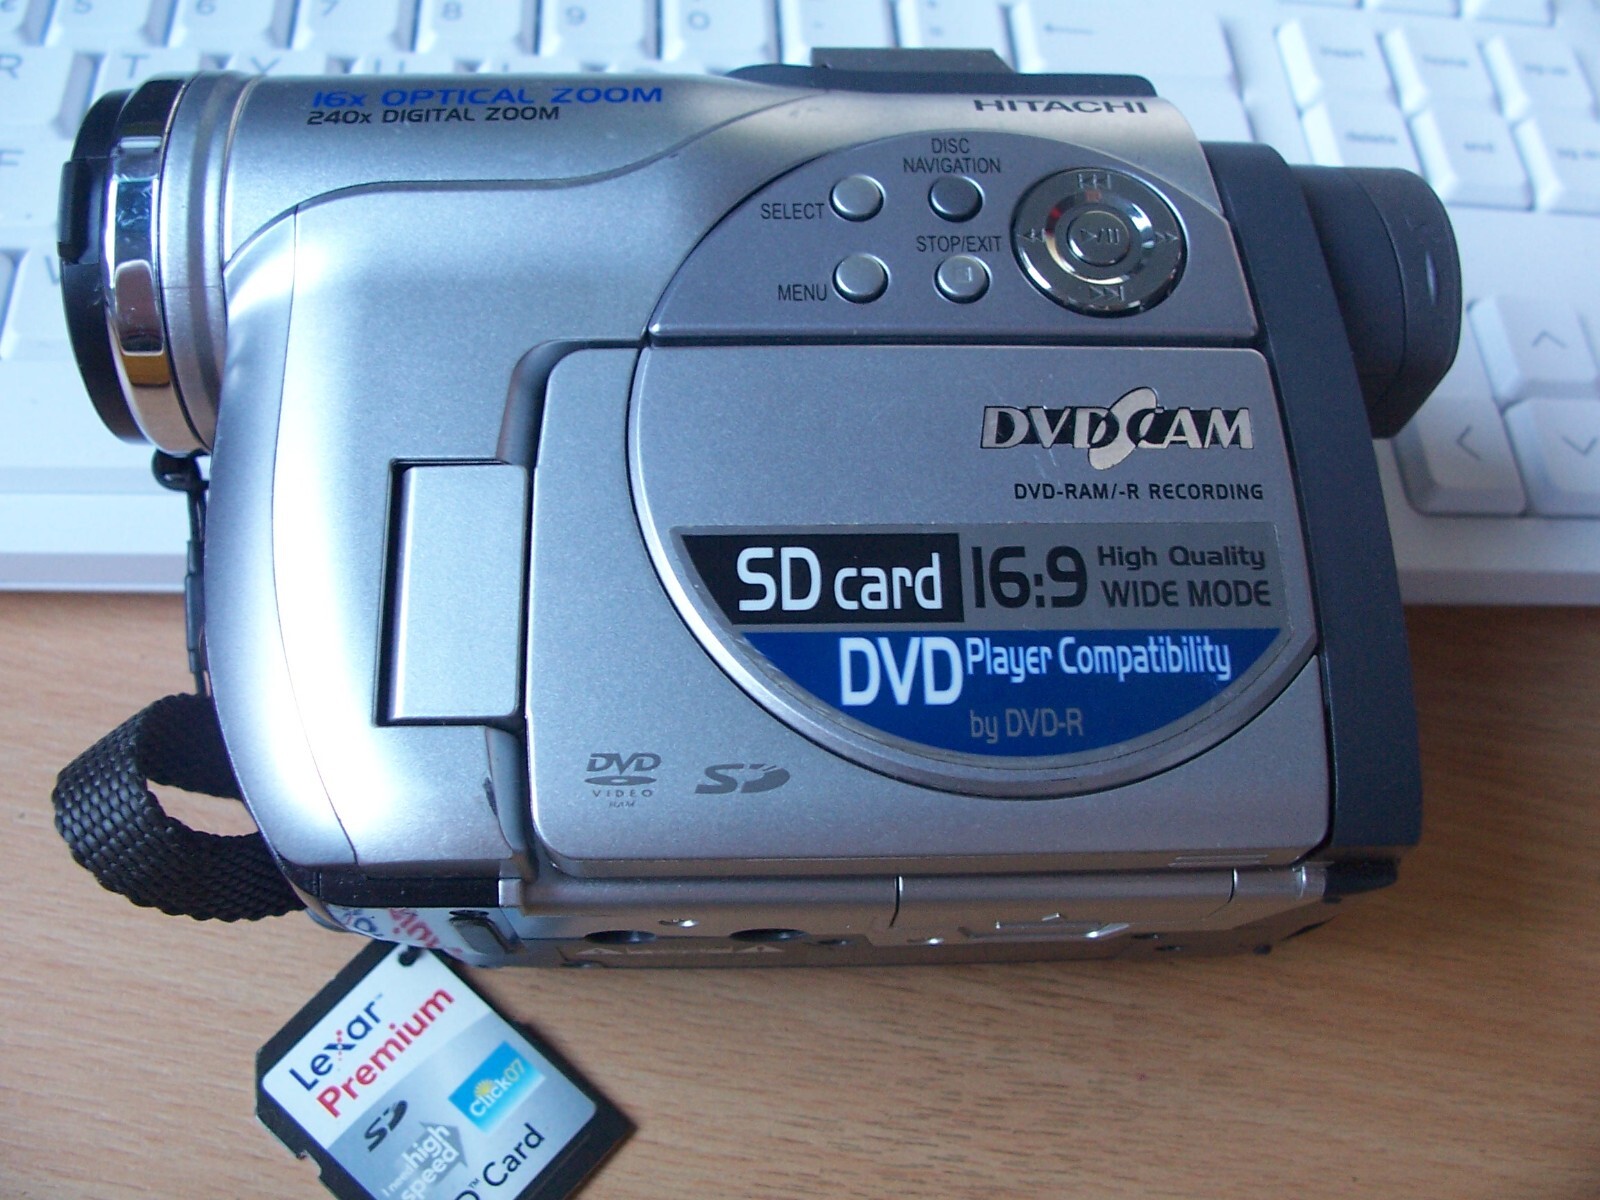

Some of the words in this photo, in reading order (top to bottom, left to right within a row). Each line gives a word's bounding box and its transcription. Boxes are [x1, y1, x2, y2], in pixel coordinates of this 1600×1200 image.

[441, 1, 463, 21] 8
[565, 5, 587, 26] 9
[121, 54, 149, 79] T
[312, 91, 368, 108] 16x
[381, 88, 533, 107] OPTICAL
[551, 86, 664, 104] ZOOM
[973, 98, 1149, 114] HITACHI
[306, 109, 373, 125] 240x
[381, 107, 476, 124] DIGITAL
[485, 106, 561, 121] ZOOM
[930, 137, 971, 155] DISC
[902, 157, 1001, 174] NAVIGATION
[760, 202, 825, 220] SELECT
[915, 235, 1002, 252] STOP/EXIT
[777, 284, 828, 302] MENU
[1014, 483, 1141, 500] DVD-RAM/-R
[1149, 483, 1265, 501] RECORDING
[1097, 545, 1160, 571] High
[1168, 546, 1267, 571] Quality
[736, 546, 822, 612] SD
[833, 551, 943, 611] card
[972, 545, 1089, 609] 16:9
[1100, 580, 1178, 608] WIDE
[1186, 579, 1272, 608] MODE
[839, 636, 964, 707] DVD
[966, 636, 1053, 684] Player
[1058, 636, 1233, 683] Compatibility
[969, 709, 999, 744] by
[1005, 708, 1085, 739] DVD-R
[586, 752, 662, 775] DVD
[694, 763, 791, 794] SD
[592, 788, 654, 798] VIDEO
[288, 996, 384, 1092] Lexar
[315, 986, 457, 1119] Premium
[401, 1124, 452, 1169] high
[482, 1121, 546, 1187] Card
[400, 1137, 460, 1200] speed
